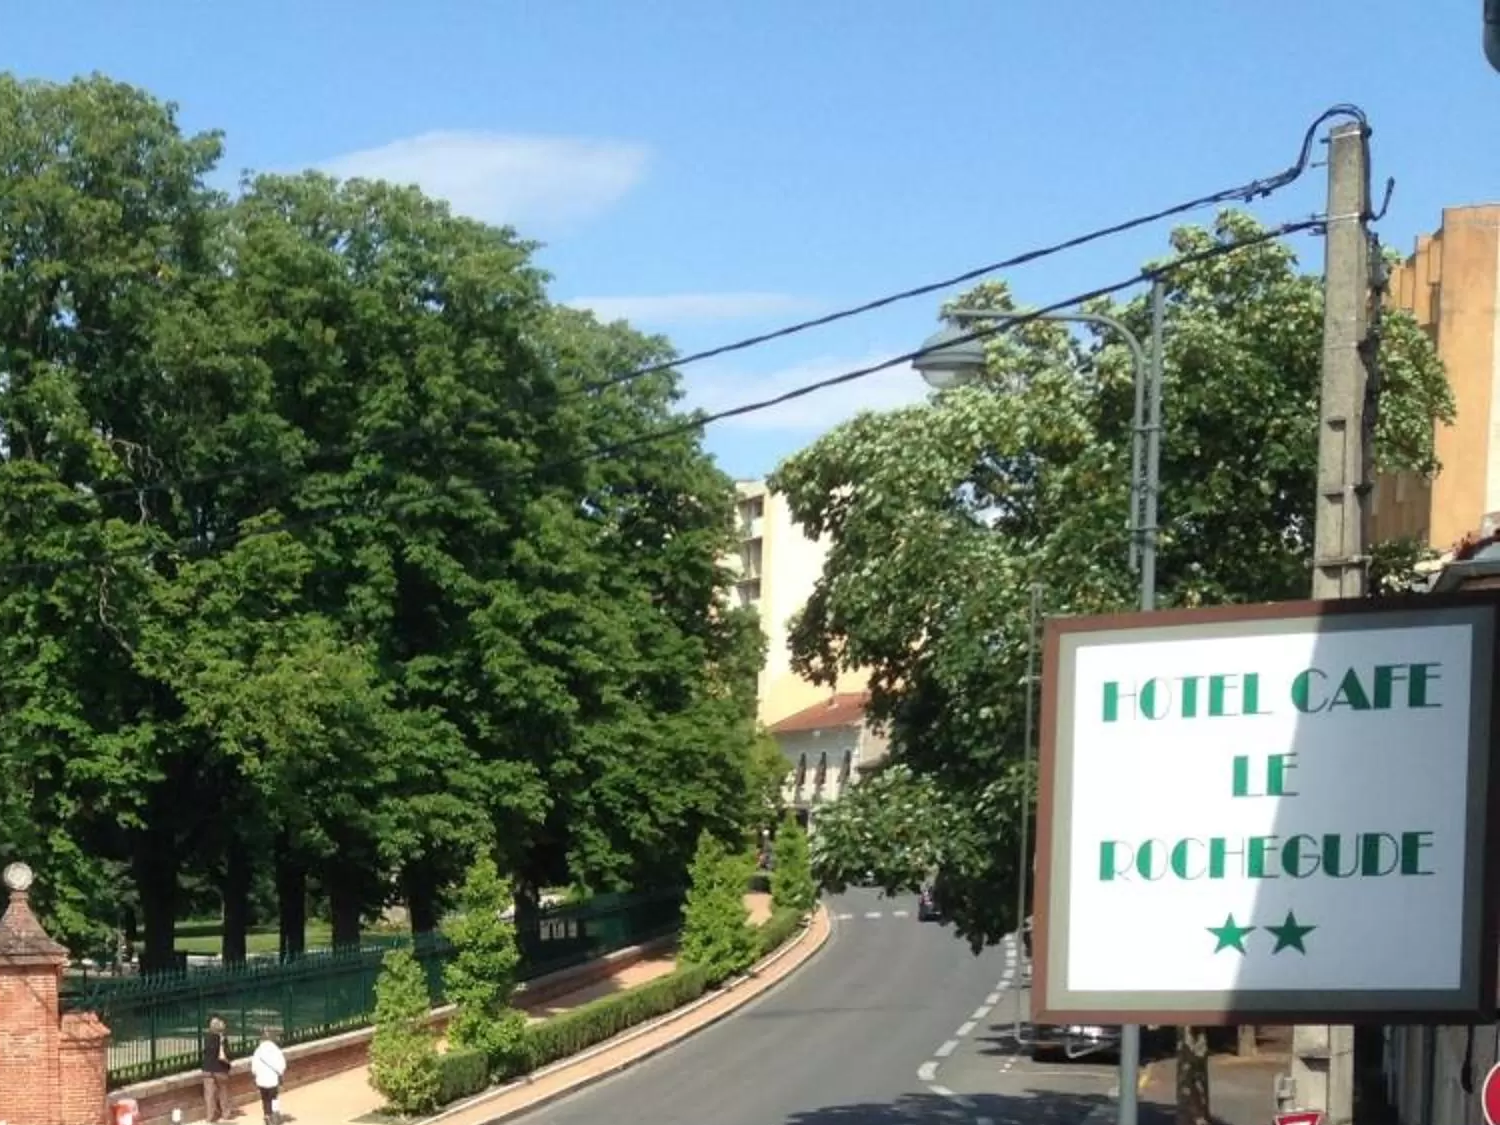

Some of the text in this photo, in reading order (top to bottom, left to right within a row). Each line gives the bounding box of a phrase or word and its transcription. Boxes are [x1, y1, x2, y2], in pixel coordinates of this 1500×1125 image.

[1102, 662, 1443, 722] HOTEL CAFE
[1232, 752, 1300, 797] LE
[1099, 831, 1436, 881] ROCHEGUDE
